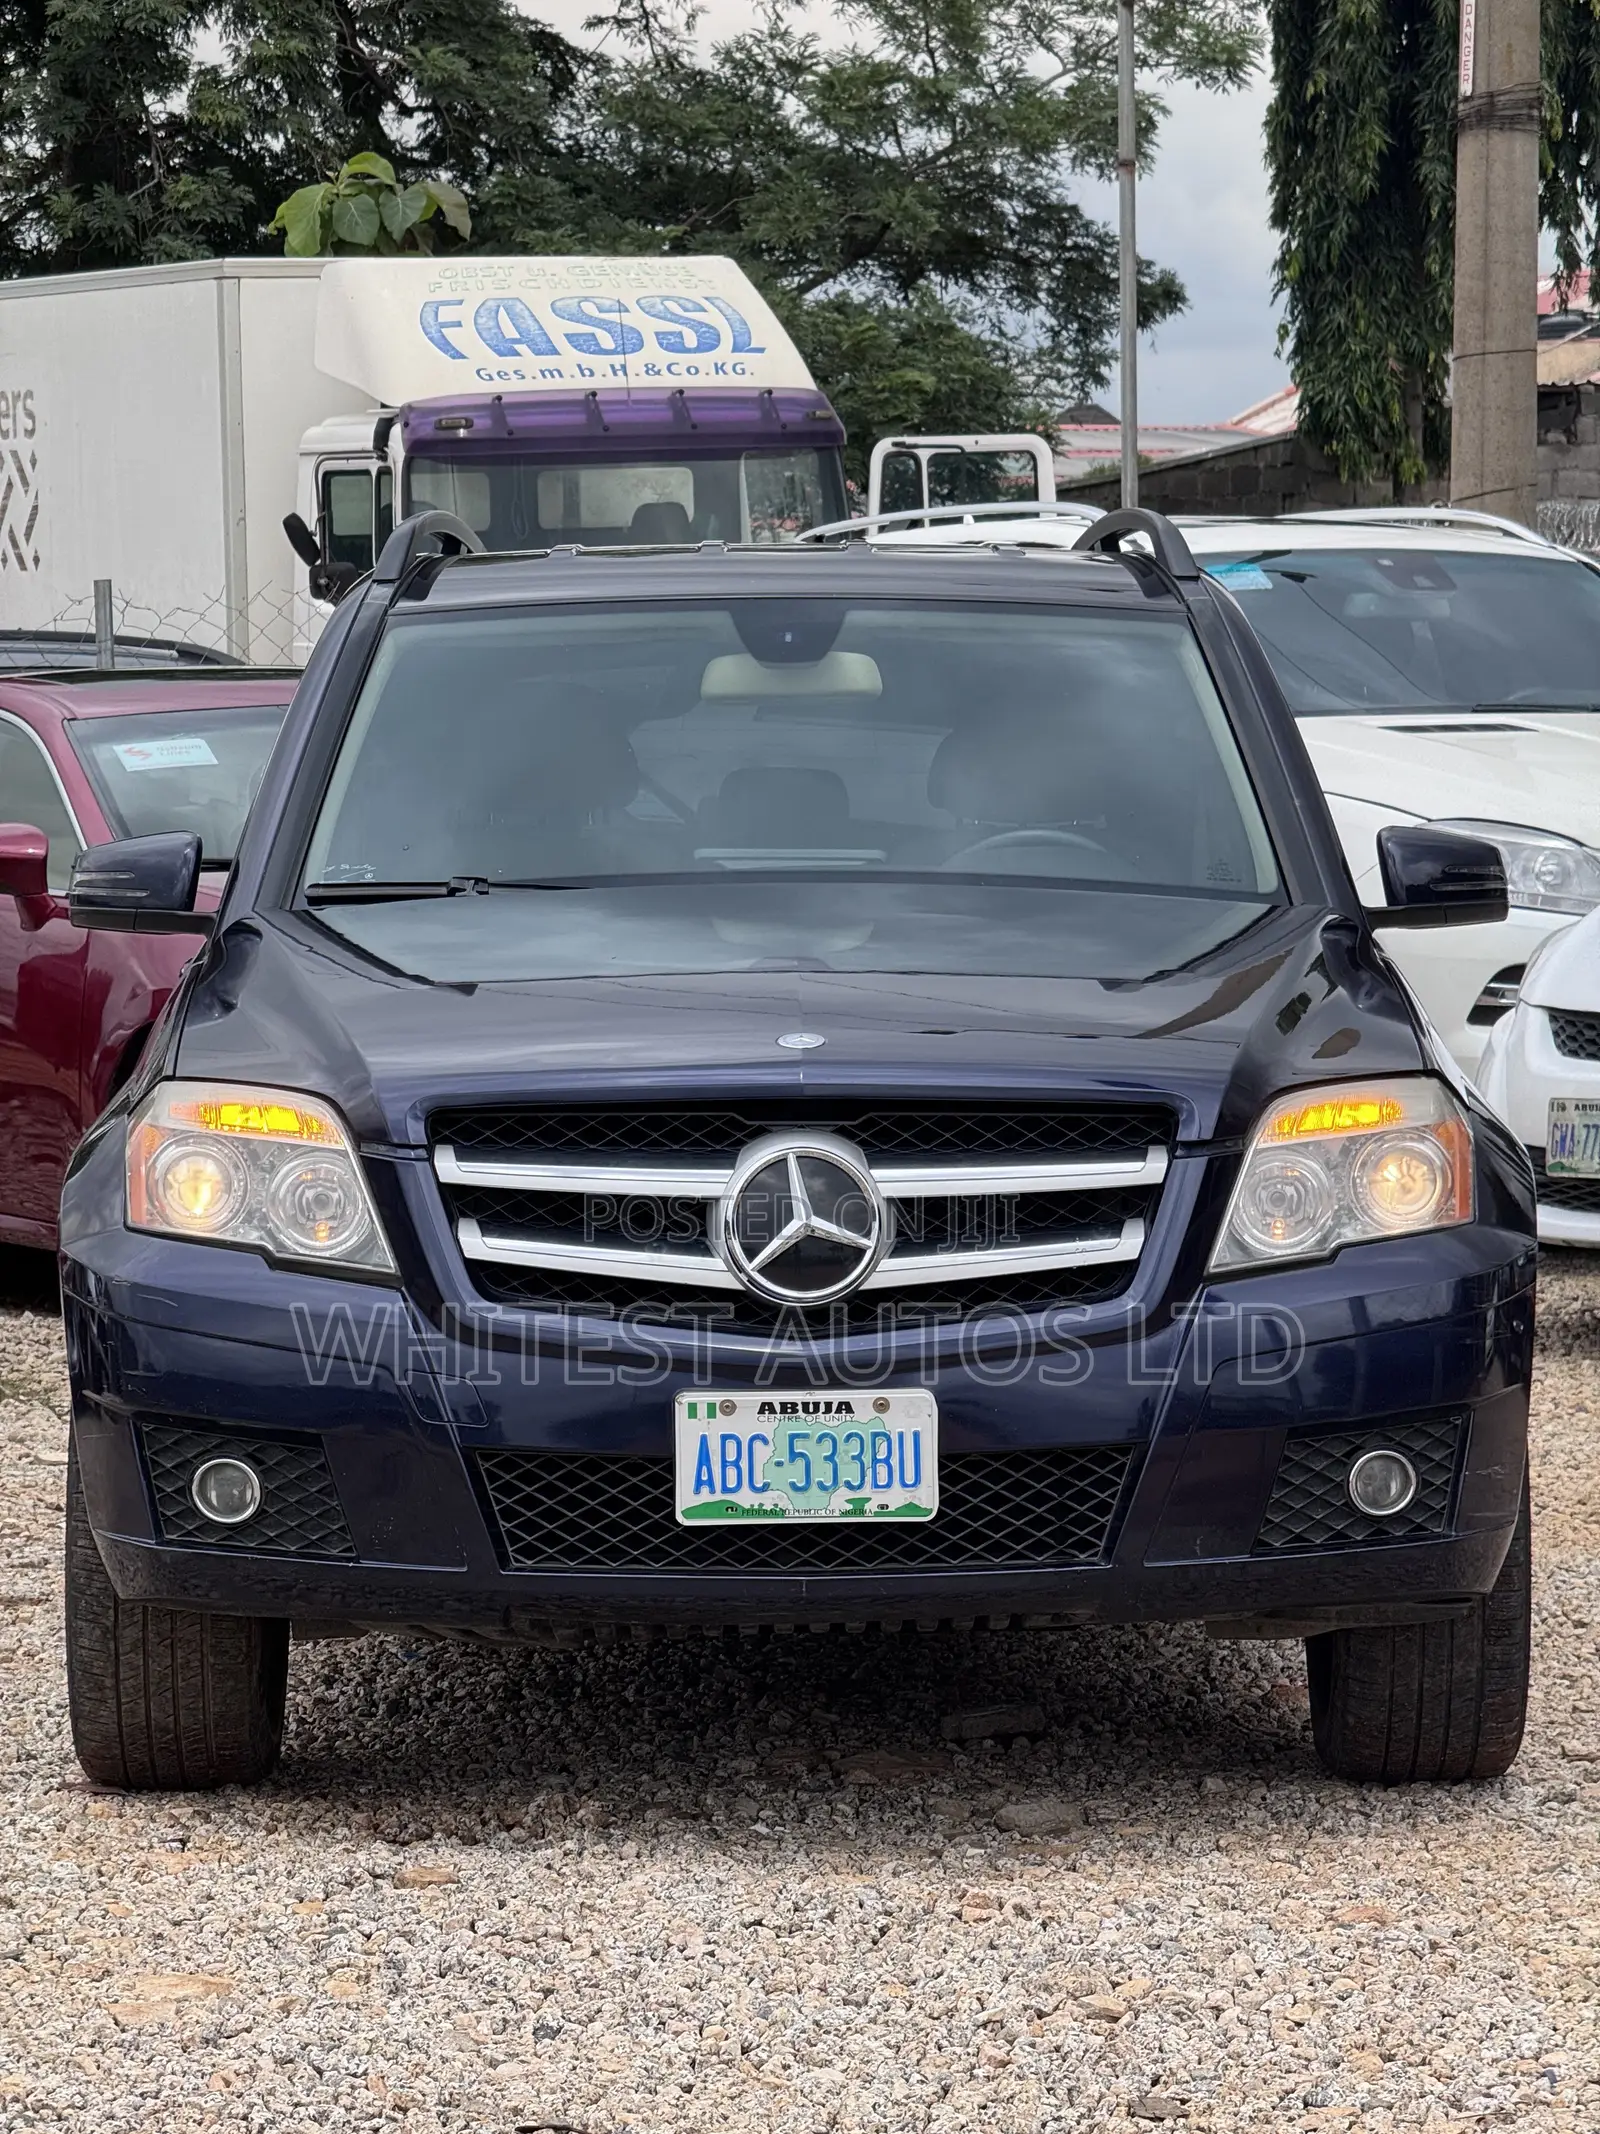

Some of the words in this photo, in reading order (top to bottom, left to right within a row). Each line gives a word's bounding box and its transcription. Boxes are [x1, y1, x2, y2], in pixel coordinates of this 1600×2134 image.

[1462, 3, 1473, 85] DANGER
[438, 266, 514, 280] OBST
[566, 262, 697, 278] GEMÜSE
[427, 278, 717, 293] FRISCHDIENST
[419, 295, 767, 360] FASSL
[1551, 1122, 1600, 1160] GWA-77
[757, 1401, 855, 1415] ABUJA
[757, 1415, 801, 1423] CENTRE
[804, 1415, 820, 1423] OF
[692, 1430, 922, 1495] ABC-533BU
[741, 1509, 780, 1517] FEDERAL
[782, 1508, 822, 1516] REPUBLIC
[824, 1508, 837, 1516] OF
[839, 1508, 873, 1516] NIGERIA
